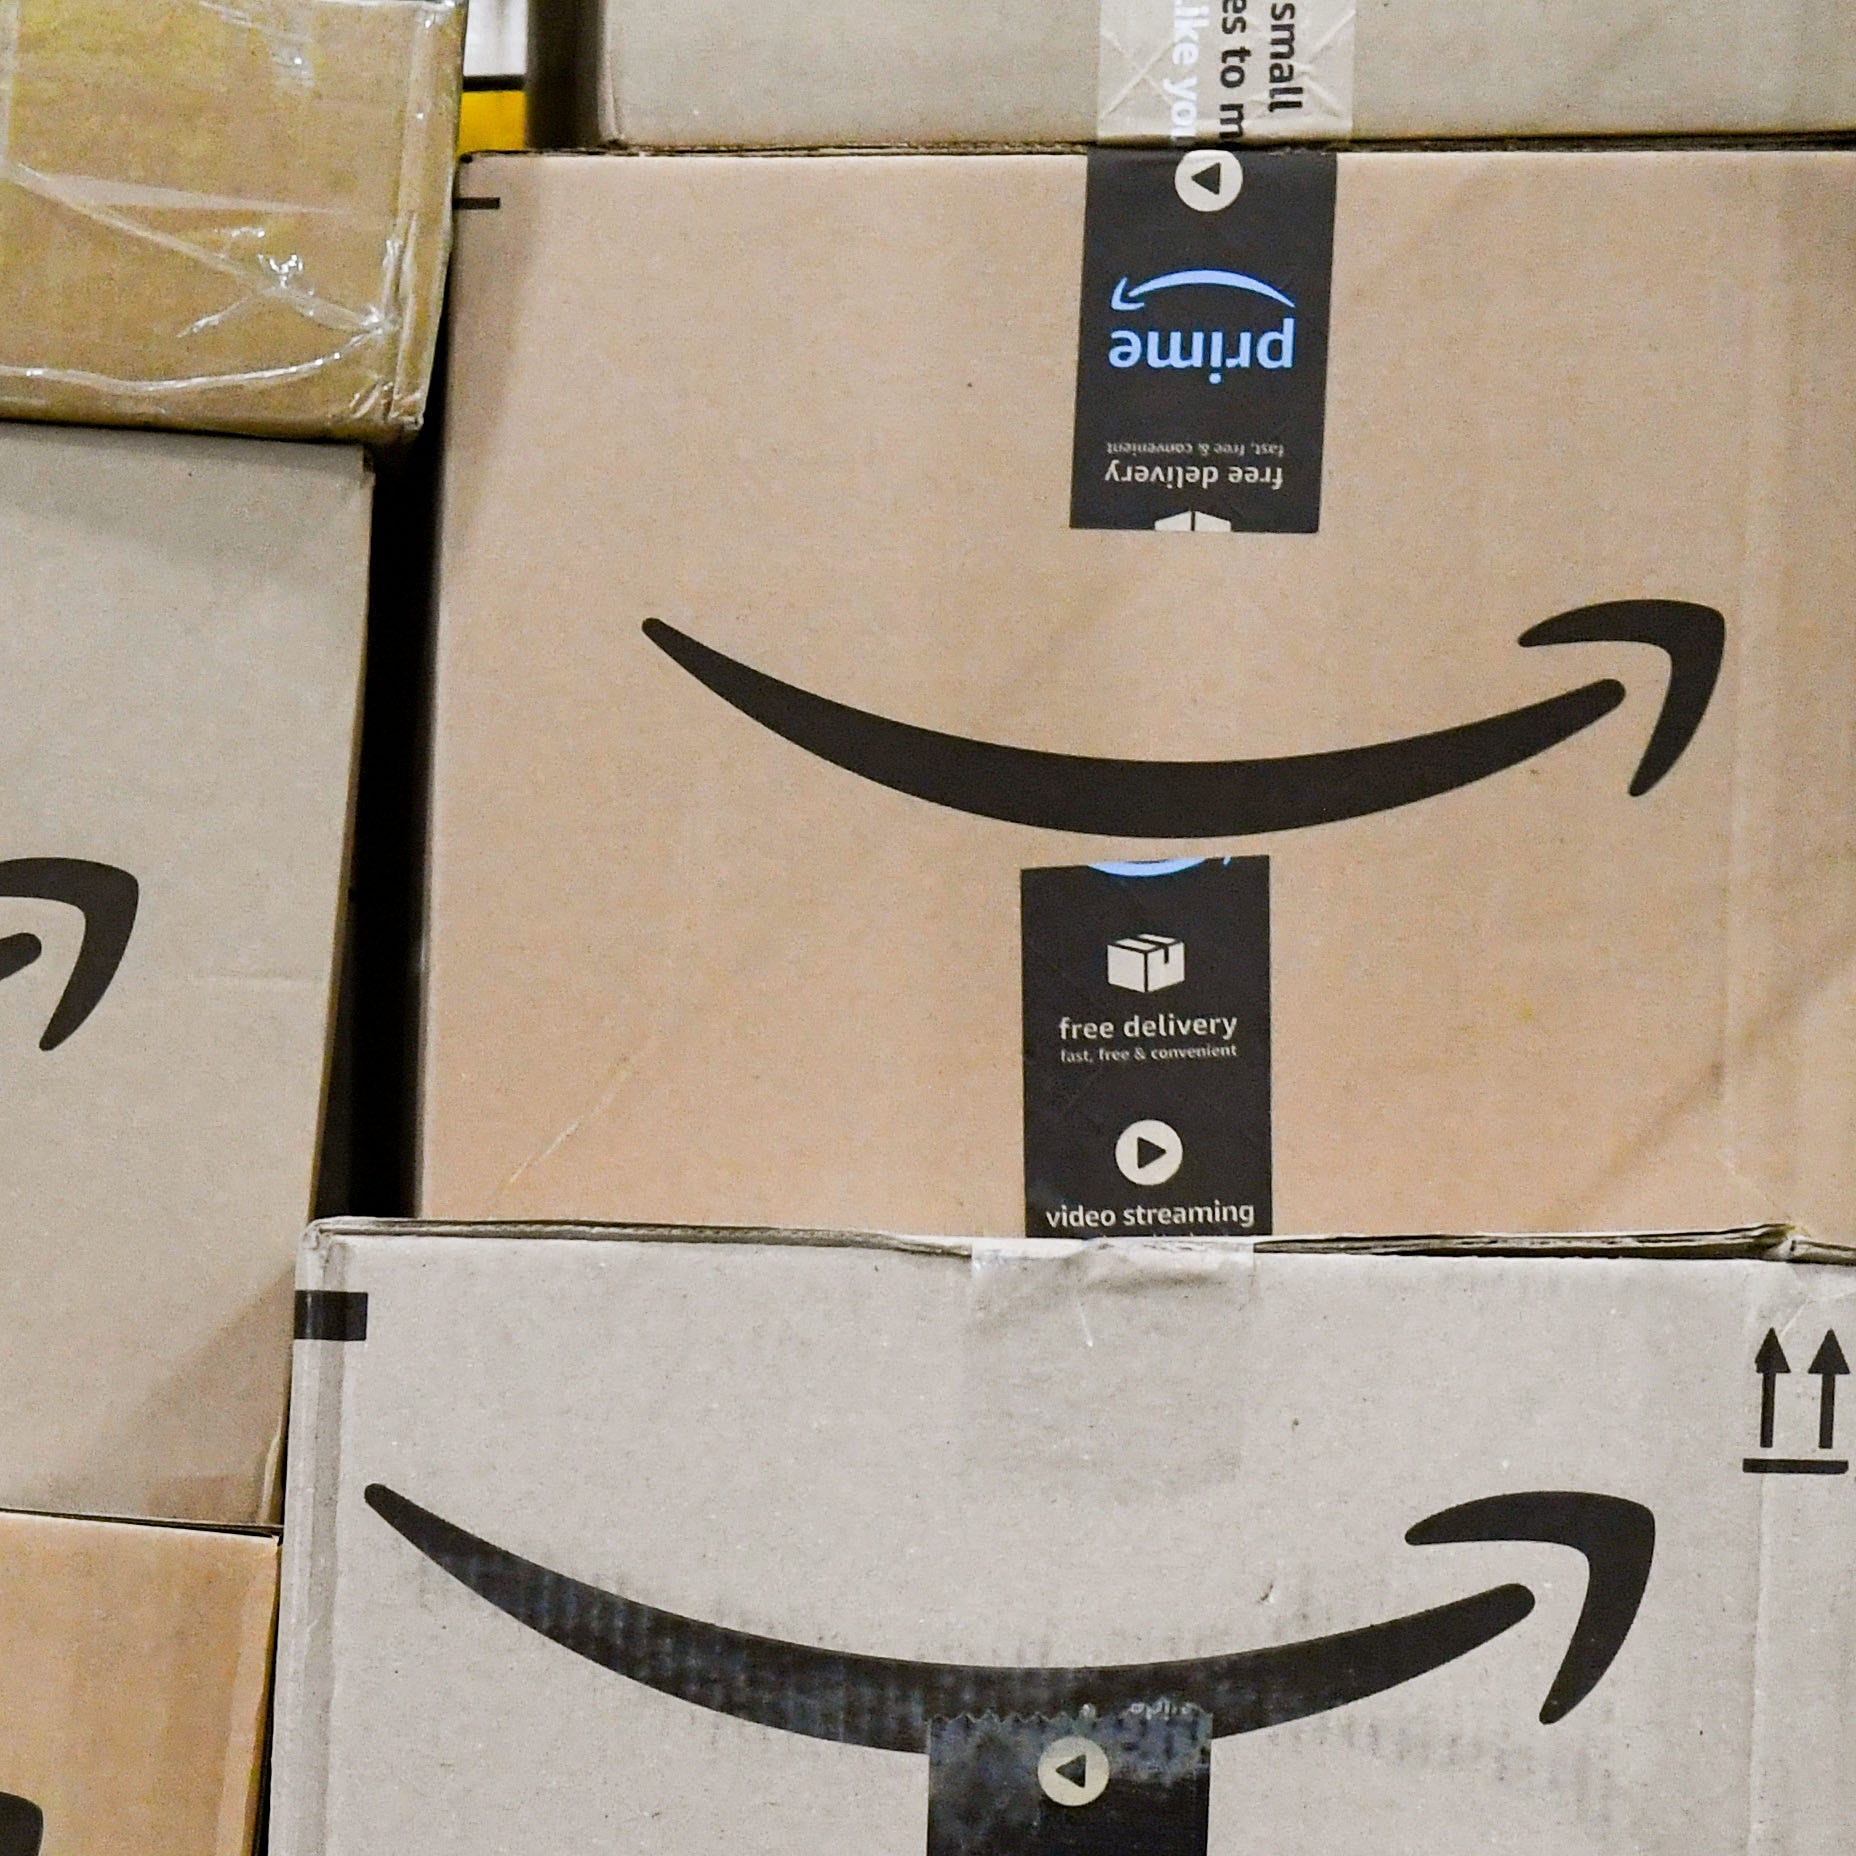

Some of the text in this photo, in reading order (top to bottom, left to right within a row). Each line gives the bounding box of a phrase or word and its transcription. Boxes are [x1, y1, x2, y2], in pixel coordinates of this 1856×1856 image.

[1220, 46, 1251, 89] to
[1268, 2, 1304, 113] small
[1108, 318, 1295, 385] prime
[1104, 459, 1285, 490] free delivery
[1059, 1013, 1238, 1040] free delivery
[1046, 1200, 1255, 1229] video streaming
